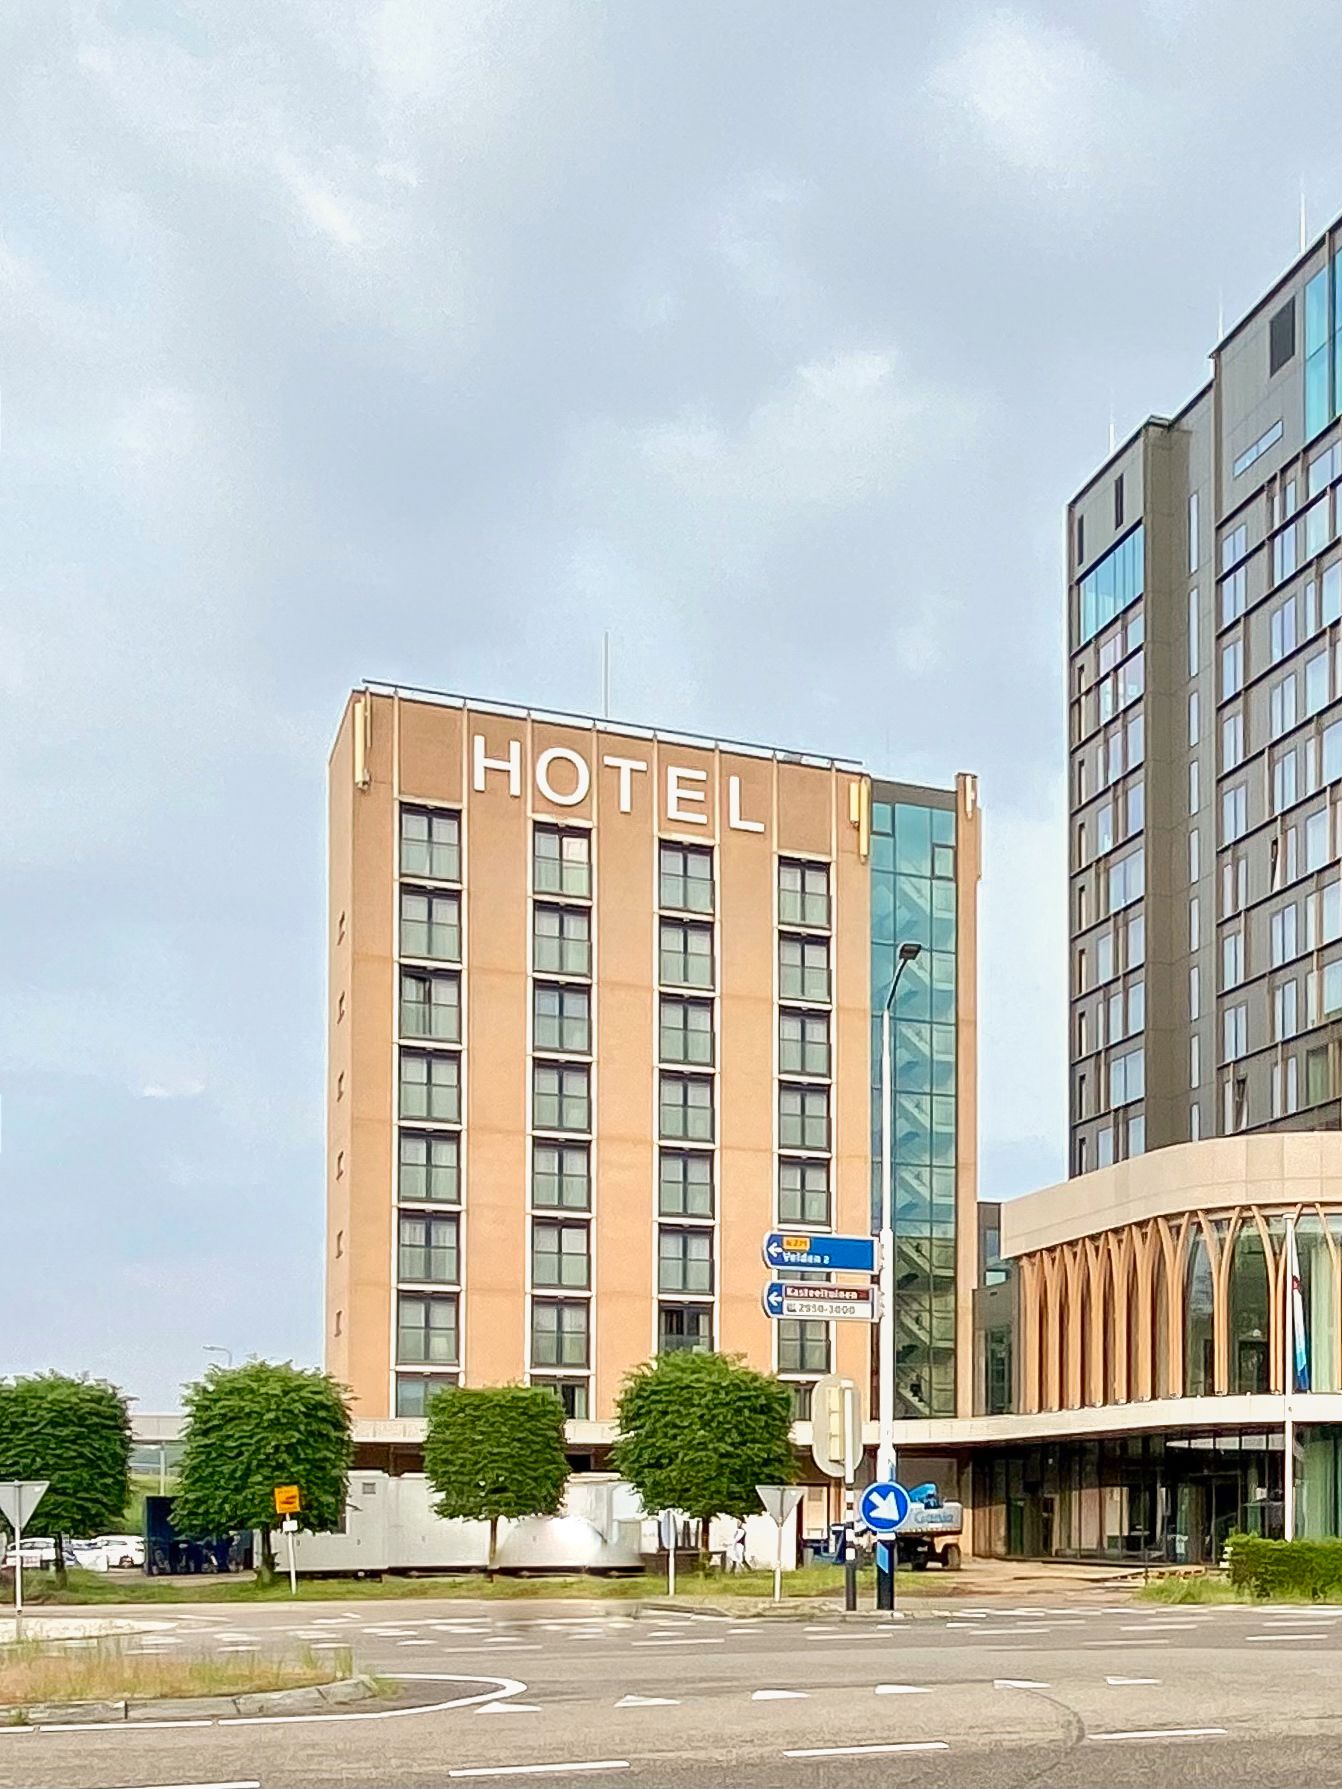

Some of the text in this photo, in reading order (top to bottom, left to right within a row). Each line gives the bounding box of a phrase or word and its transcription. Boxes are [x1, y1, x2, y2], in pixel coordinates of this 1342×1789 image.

[473, 735, 765, 833] HOTEL
[782, 1251, 822, 1264] Velden
[786, 1287, 858, 1300] Kasteeltuinen
